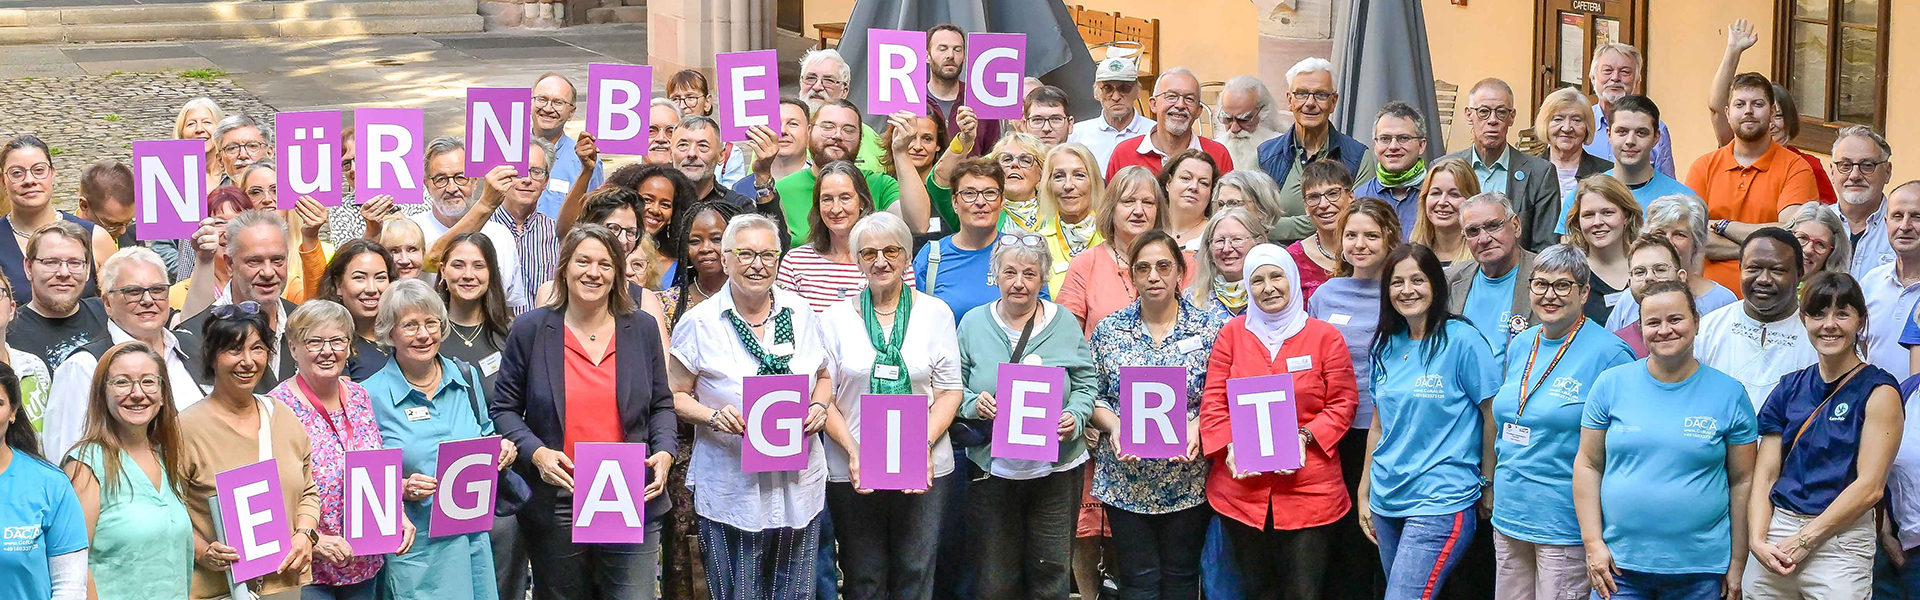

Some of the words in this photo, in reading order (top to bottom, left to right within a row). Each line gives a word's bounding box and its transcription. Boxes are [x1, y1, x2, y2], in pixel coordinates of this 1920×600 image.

[1573, 0, 1602, 12] CAFETERIA
[730, 65, 777, 129] E
[879, 42, 921, 104] R
[970, 46, 1019, 106] G
[470, 101, 525, 163] N
[597, 79, 642, 141] B
[140, 155, 201, 224] N
[366, 123, 417, 190] R
[748, 389, 802, 458] G
[886, 409, 901, 474] I
[1007, 379, 1051, 447] E
[1131, 381, 1180, 445] R
[1236, 389, 1287, 458] T
[350, 464, 397, 539] N
[438, 453, 493, 520] G
[574, 459, 643, 528] A
[232, 479, 282, 563] E
